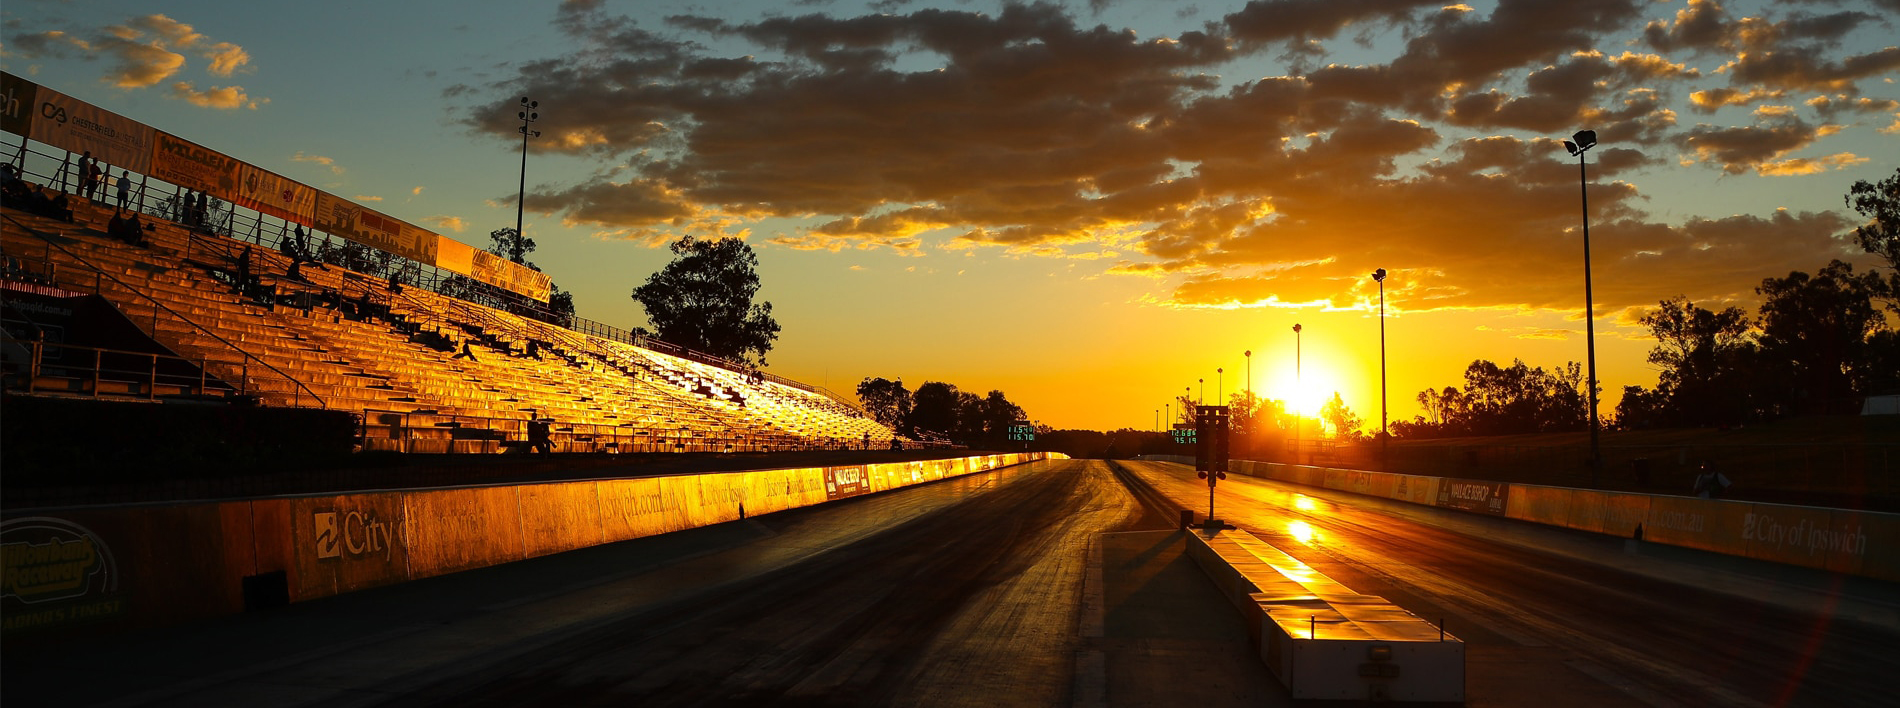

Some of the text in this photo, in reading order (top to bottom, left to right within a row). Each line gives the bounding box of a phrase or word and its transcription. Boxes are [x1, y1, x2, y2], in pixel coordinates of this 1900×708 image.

[71, 115, 116, 138] CHESTERFIELD
[115, 130, 147, 149] AUSTRALIA
[160, 135, 237, 174] WILCLEAN
[345, 511, 394, 562] City
[1757, 515, 1867, 556] City of Ipswich
